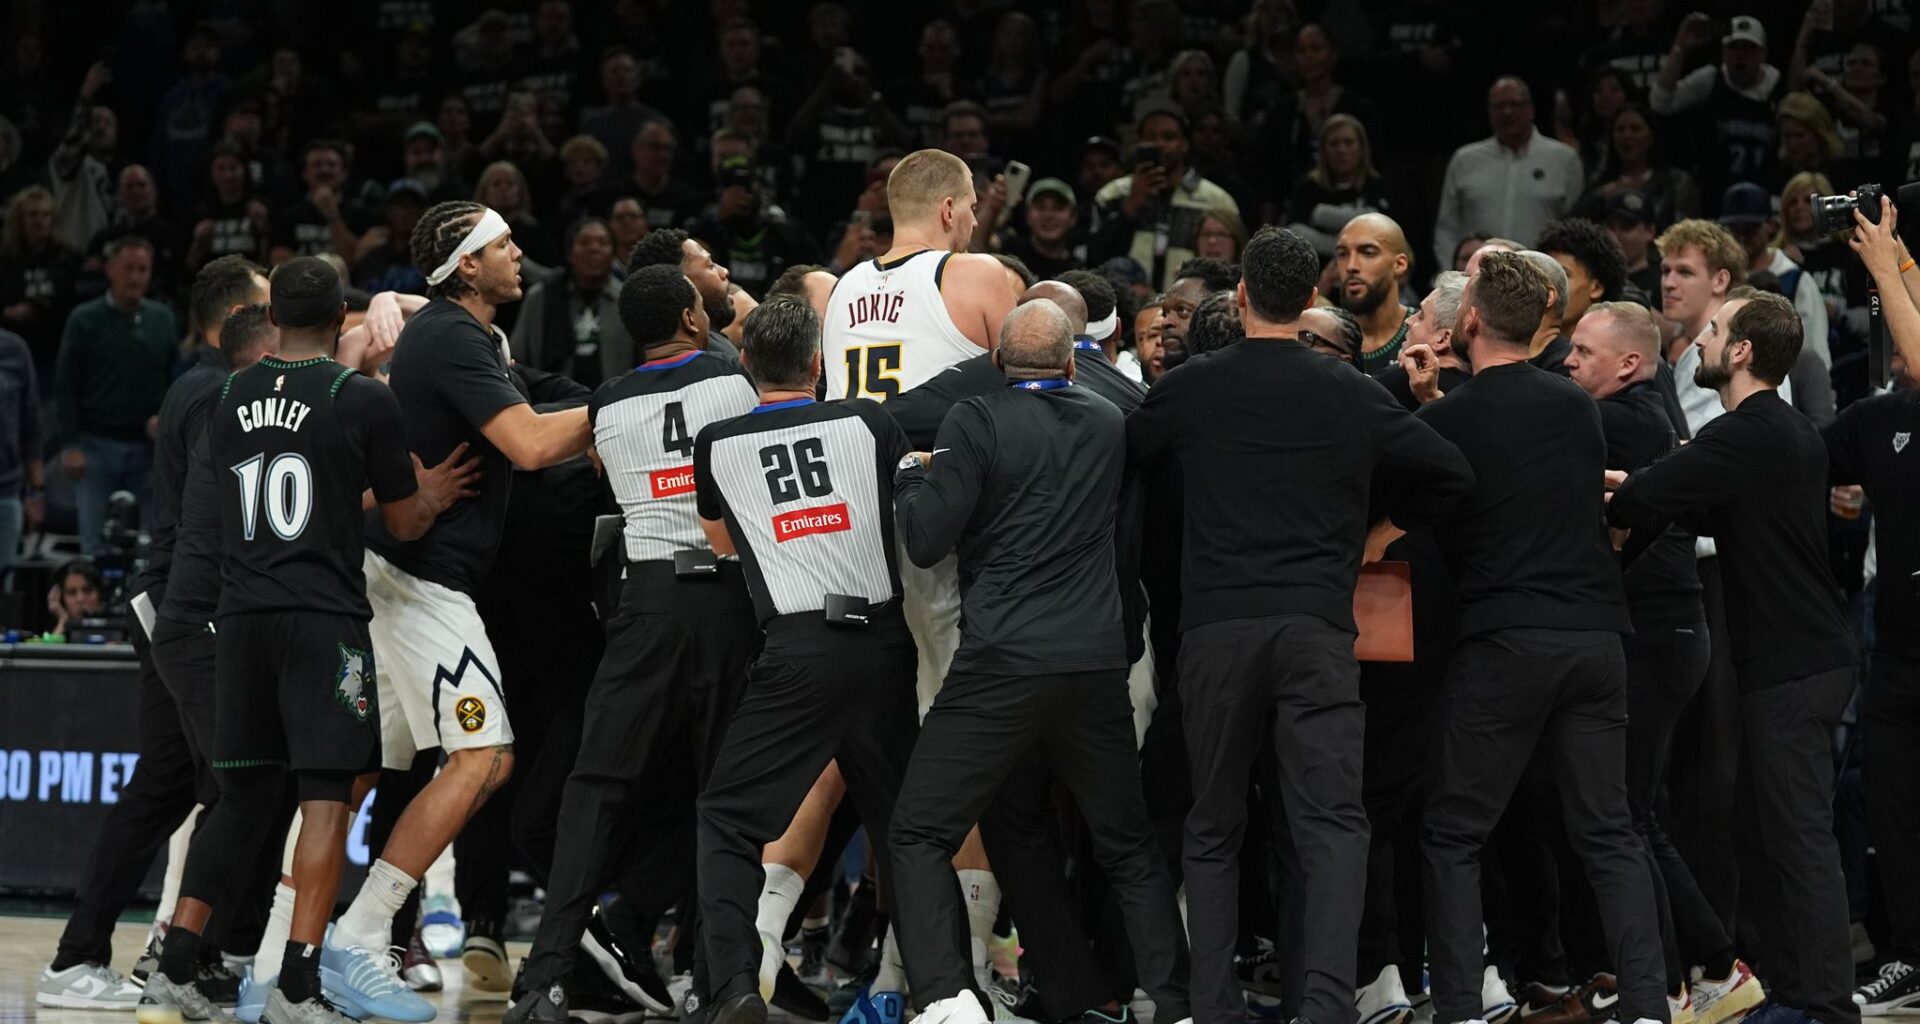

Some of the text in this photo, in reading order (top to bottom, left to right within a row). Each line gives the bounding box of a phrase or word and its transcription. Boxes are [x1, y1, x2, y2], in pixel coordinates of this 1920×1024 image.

[848, 290, 904, 328] JOKIĆ
[844, 341, 903, 404] 15
[236, 397, 311, 433] CONLEY
[663, 401, 694, 458] 4
[229, 451, 314, 542] 10
[656, 472, 697, 491] Emira
[759, 437, 833, 505] 26
[780, 512, 843, 534] Emirates
[38, 750, 94, 803] PM
[100, 752, 141, 804] ET
